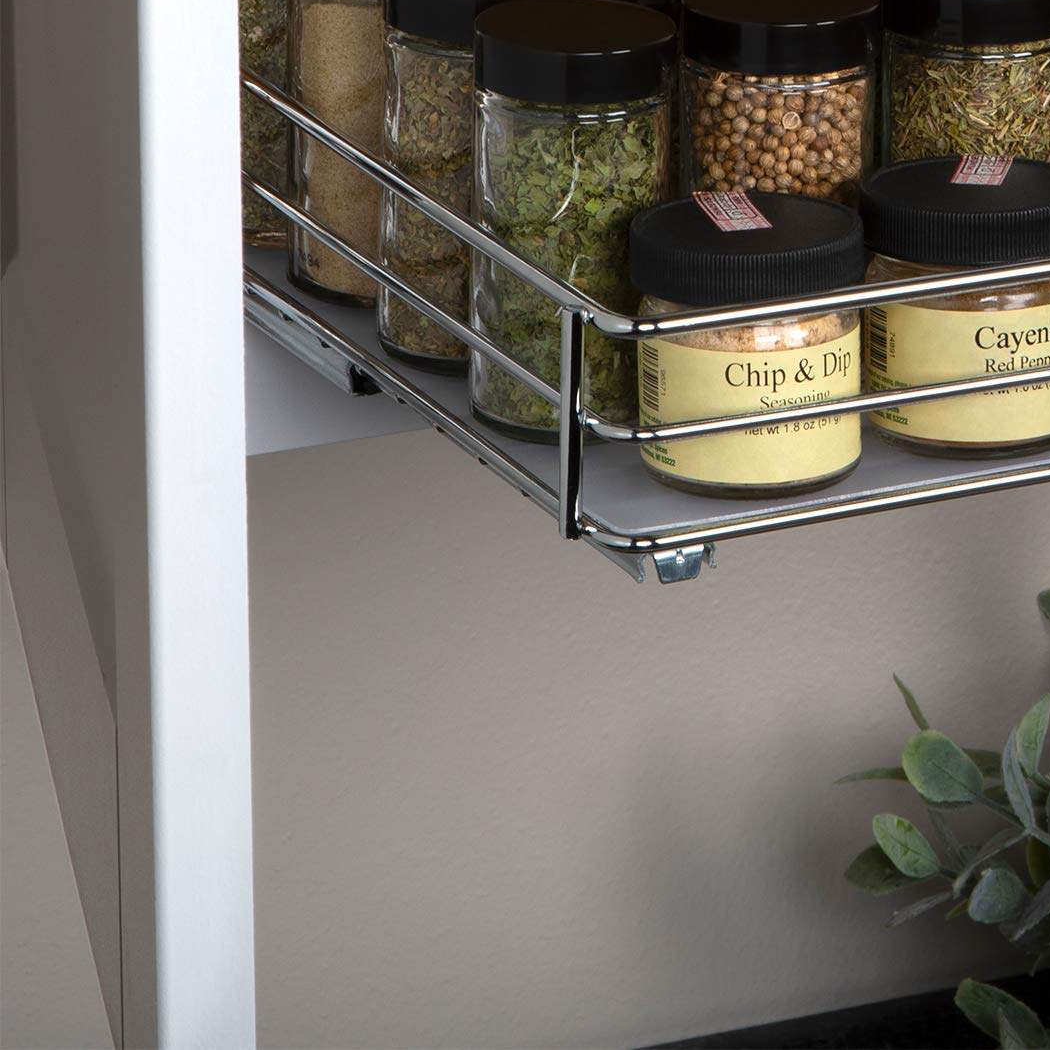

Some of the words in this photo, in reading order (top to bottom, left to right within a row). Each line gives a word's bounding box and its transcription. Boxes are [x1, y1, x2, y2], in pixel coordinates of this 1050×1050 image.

[724, 361, 786, 393] Chip
[794, 358, 816, 384] &
[823, 347, 852, 378] Dip
[985, 357, 1015, 373] Red
[766, 425, 780, 435] wt
[783, 423, 800, 434] 1.8
[803, 421, 816, 431] oz
